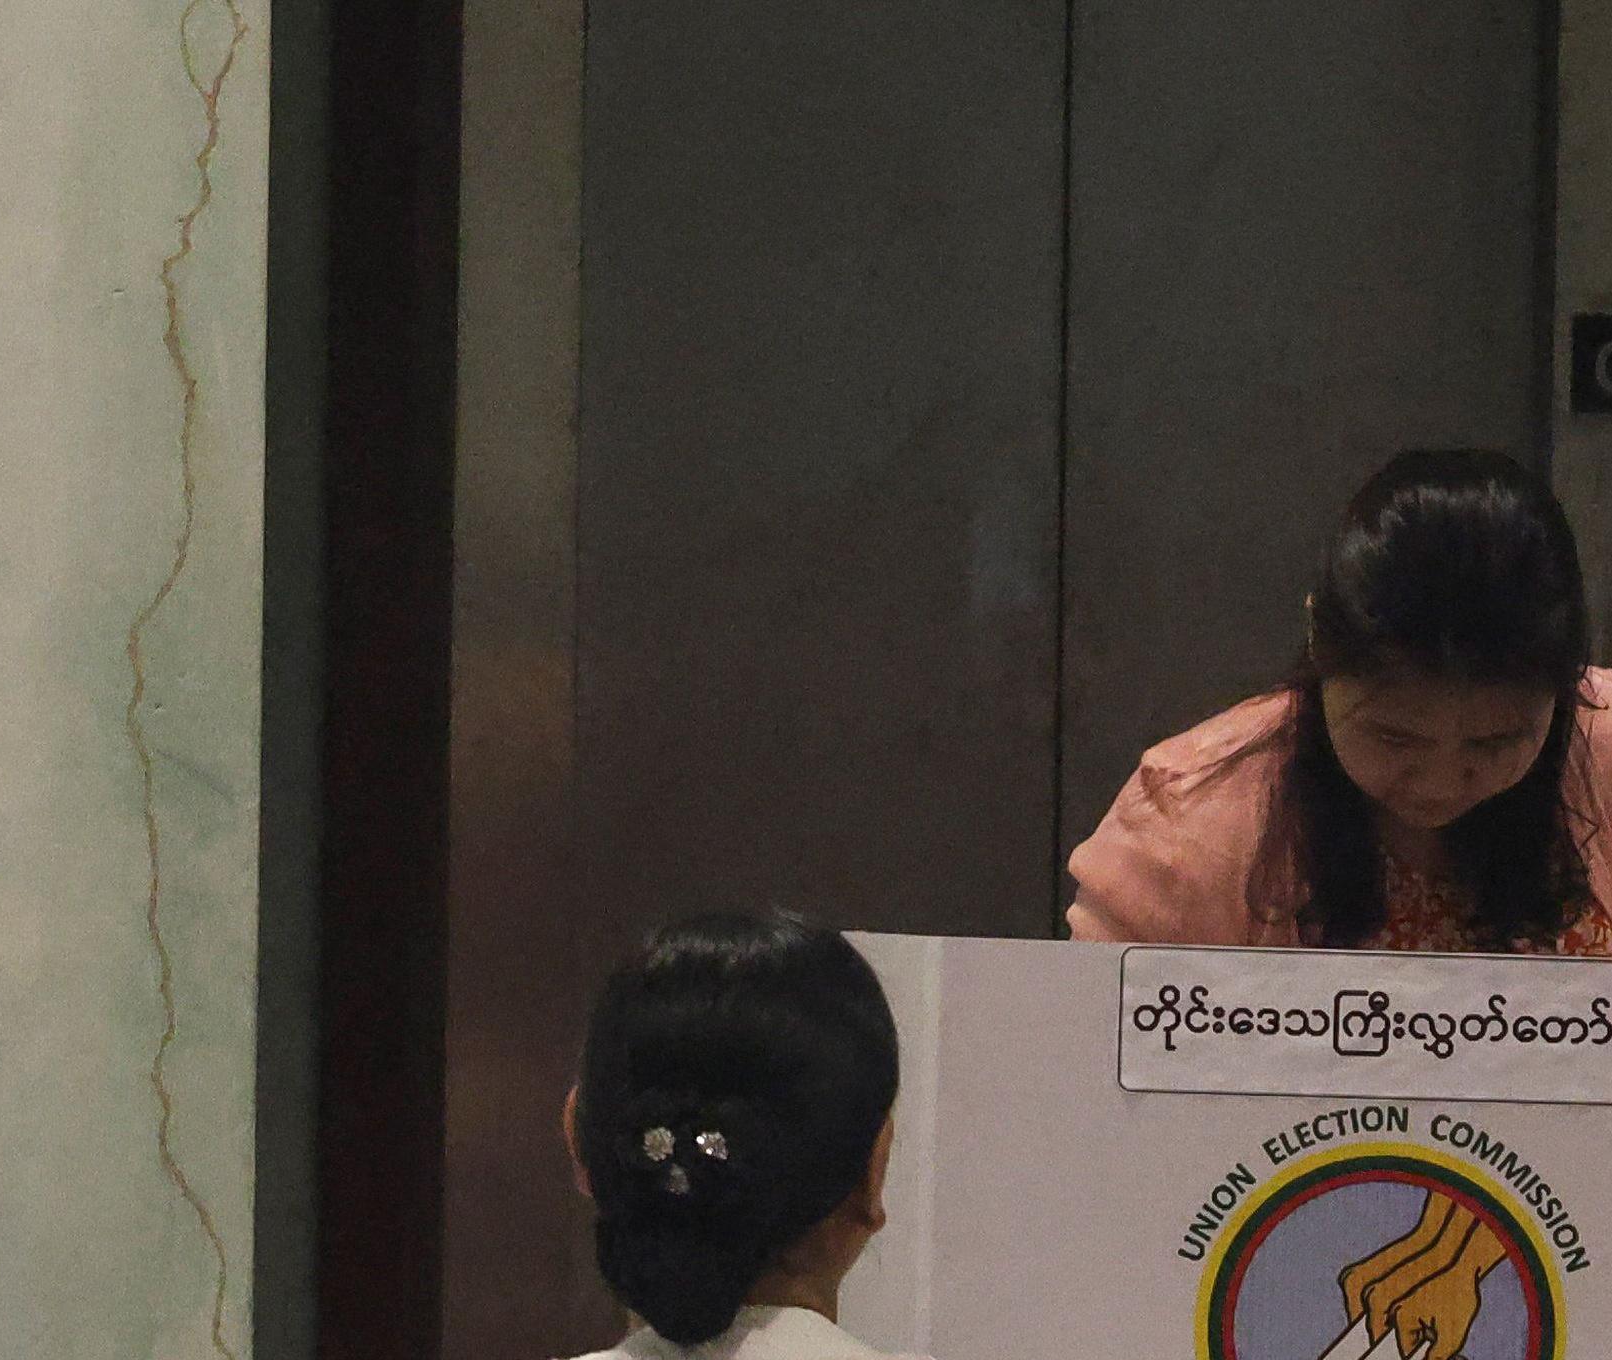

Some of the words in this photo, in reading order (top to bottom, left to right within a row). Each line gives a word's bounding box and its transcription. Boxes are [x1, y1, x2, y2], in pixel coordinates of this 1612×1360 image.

[1177, 1162, 1257, 1263] UNION
[1261, 1105, 1409, 1166] ELECTION
[1430, 1113, 1591, 1274] COMMISSION
